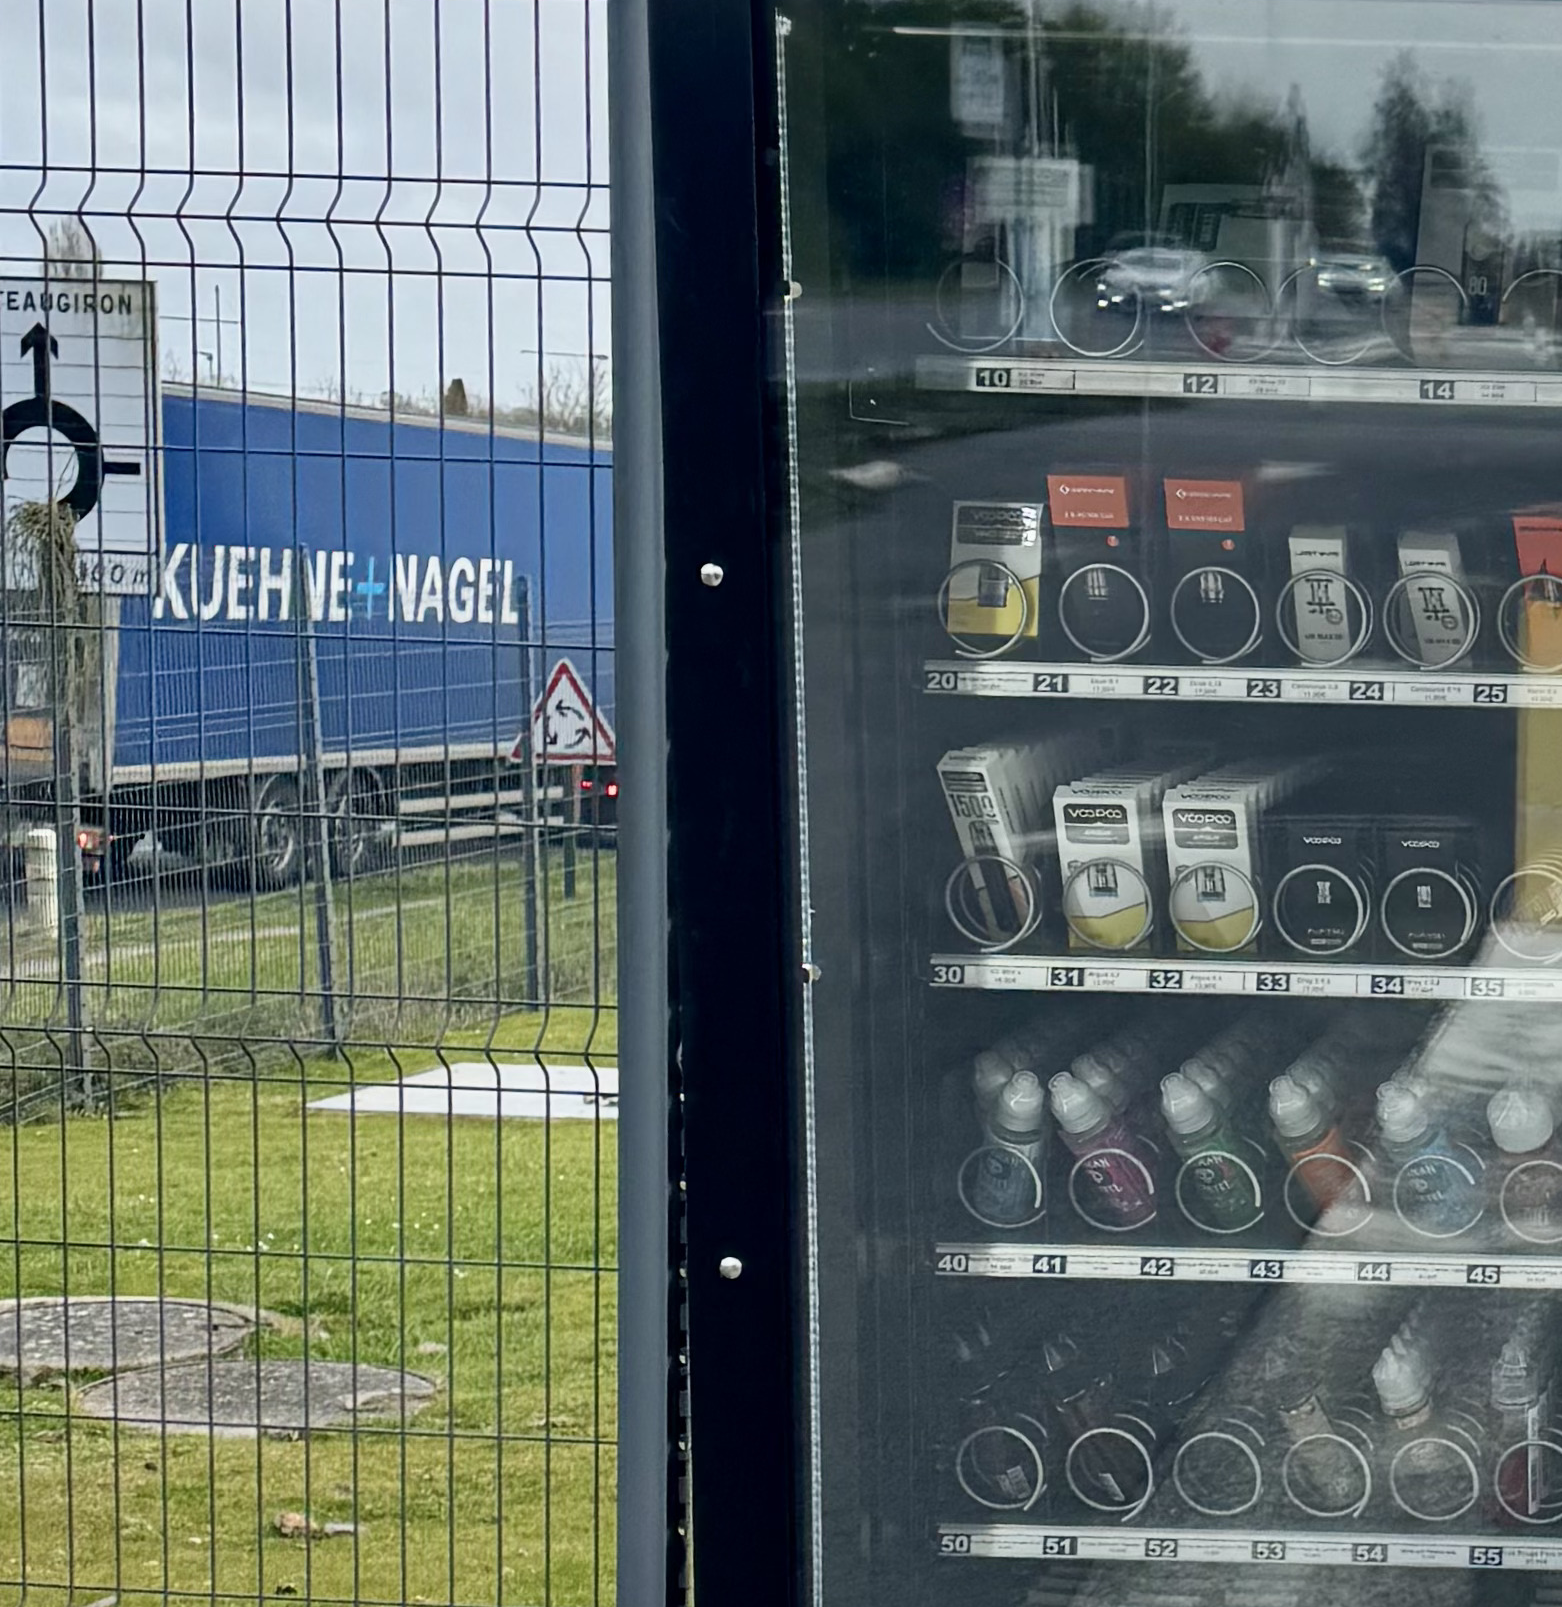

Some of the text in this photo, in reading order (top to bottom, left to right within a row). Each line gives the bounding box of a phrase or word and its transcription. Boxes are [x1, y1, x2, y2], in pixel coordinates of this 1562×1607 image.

[0, 290, 132, 315] EAUGIRON
[978, 369, 1008, 387] 10
[1186, 375, 1216, 393] 12
[1422, 382, 1452, 398] 14
[926, 673, 955, 689] 20
[1036, 675, 1064, 691] 21
[1146, 678, 1176, 694] 22
[1250, 680, 1278, 697] 23
[1352, 683, 1382, 699] 24
[1476, 687, 1506, 701] 25
[1067, 808, 1123, 819] VOOPOO
[1177, 813, 1232, 824] VOOPOO
[933, 966, 962, 982] 30
[1053, 969, 1082, 985] 31
[1152, 972, 1181, 988] 32
[1259, 975, 1288, 991] 33
[1372, 976, 1402, 993] 34
[1472, 979, 1502, 995] 35
[937, 1255, 967, 1271] 40
[1034, 1257, 1063, 1273] 41
[1142, 1259, 1172, 1275] 42
[1252, 1262, 1280, 1277] 43
[1359, 1264, 1389, 1279] 44
[1469, 1267, 1498, 1283] 45
[941, 1535, 969, 1552] 50
[1044, 1538, 1072, 1554] 51
[1148, 1541, 1176, 1556] 52
[1256, 1543, 1283, 1559] 53
[1356, 1545, 1384, 1561] 54
[1472, 1548, 1500, 1565] 55
